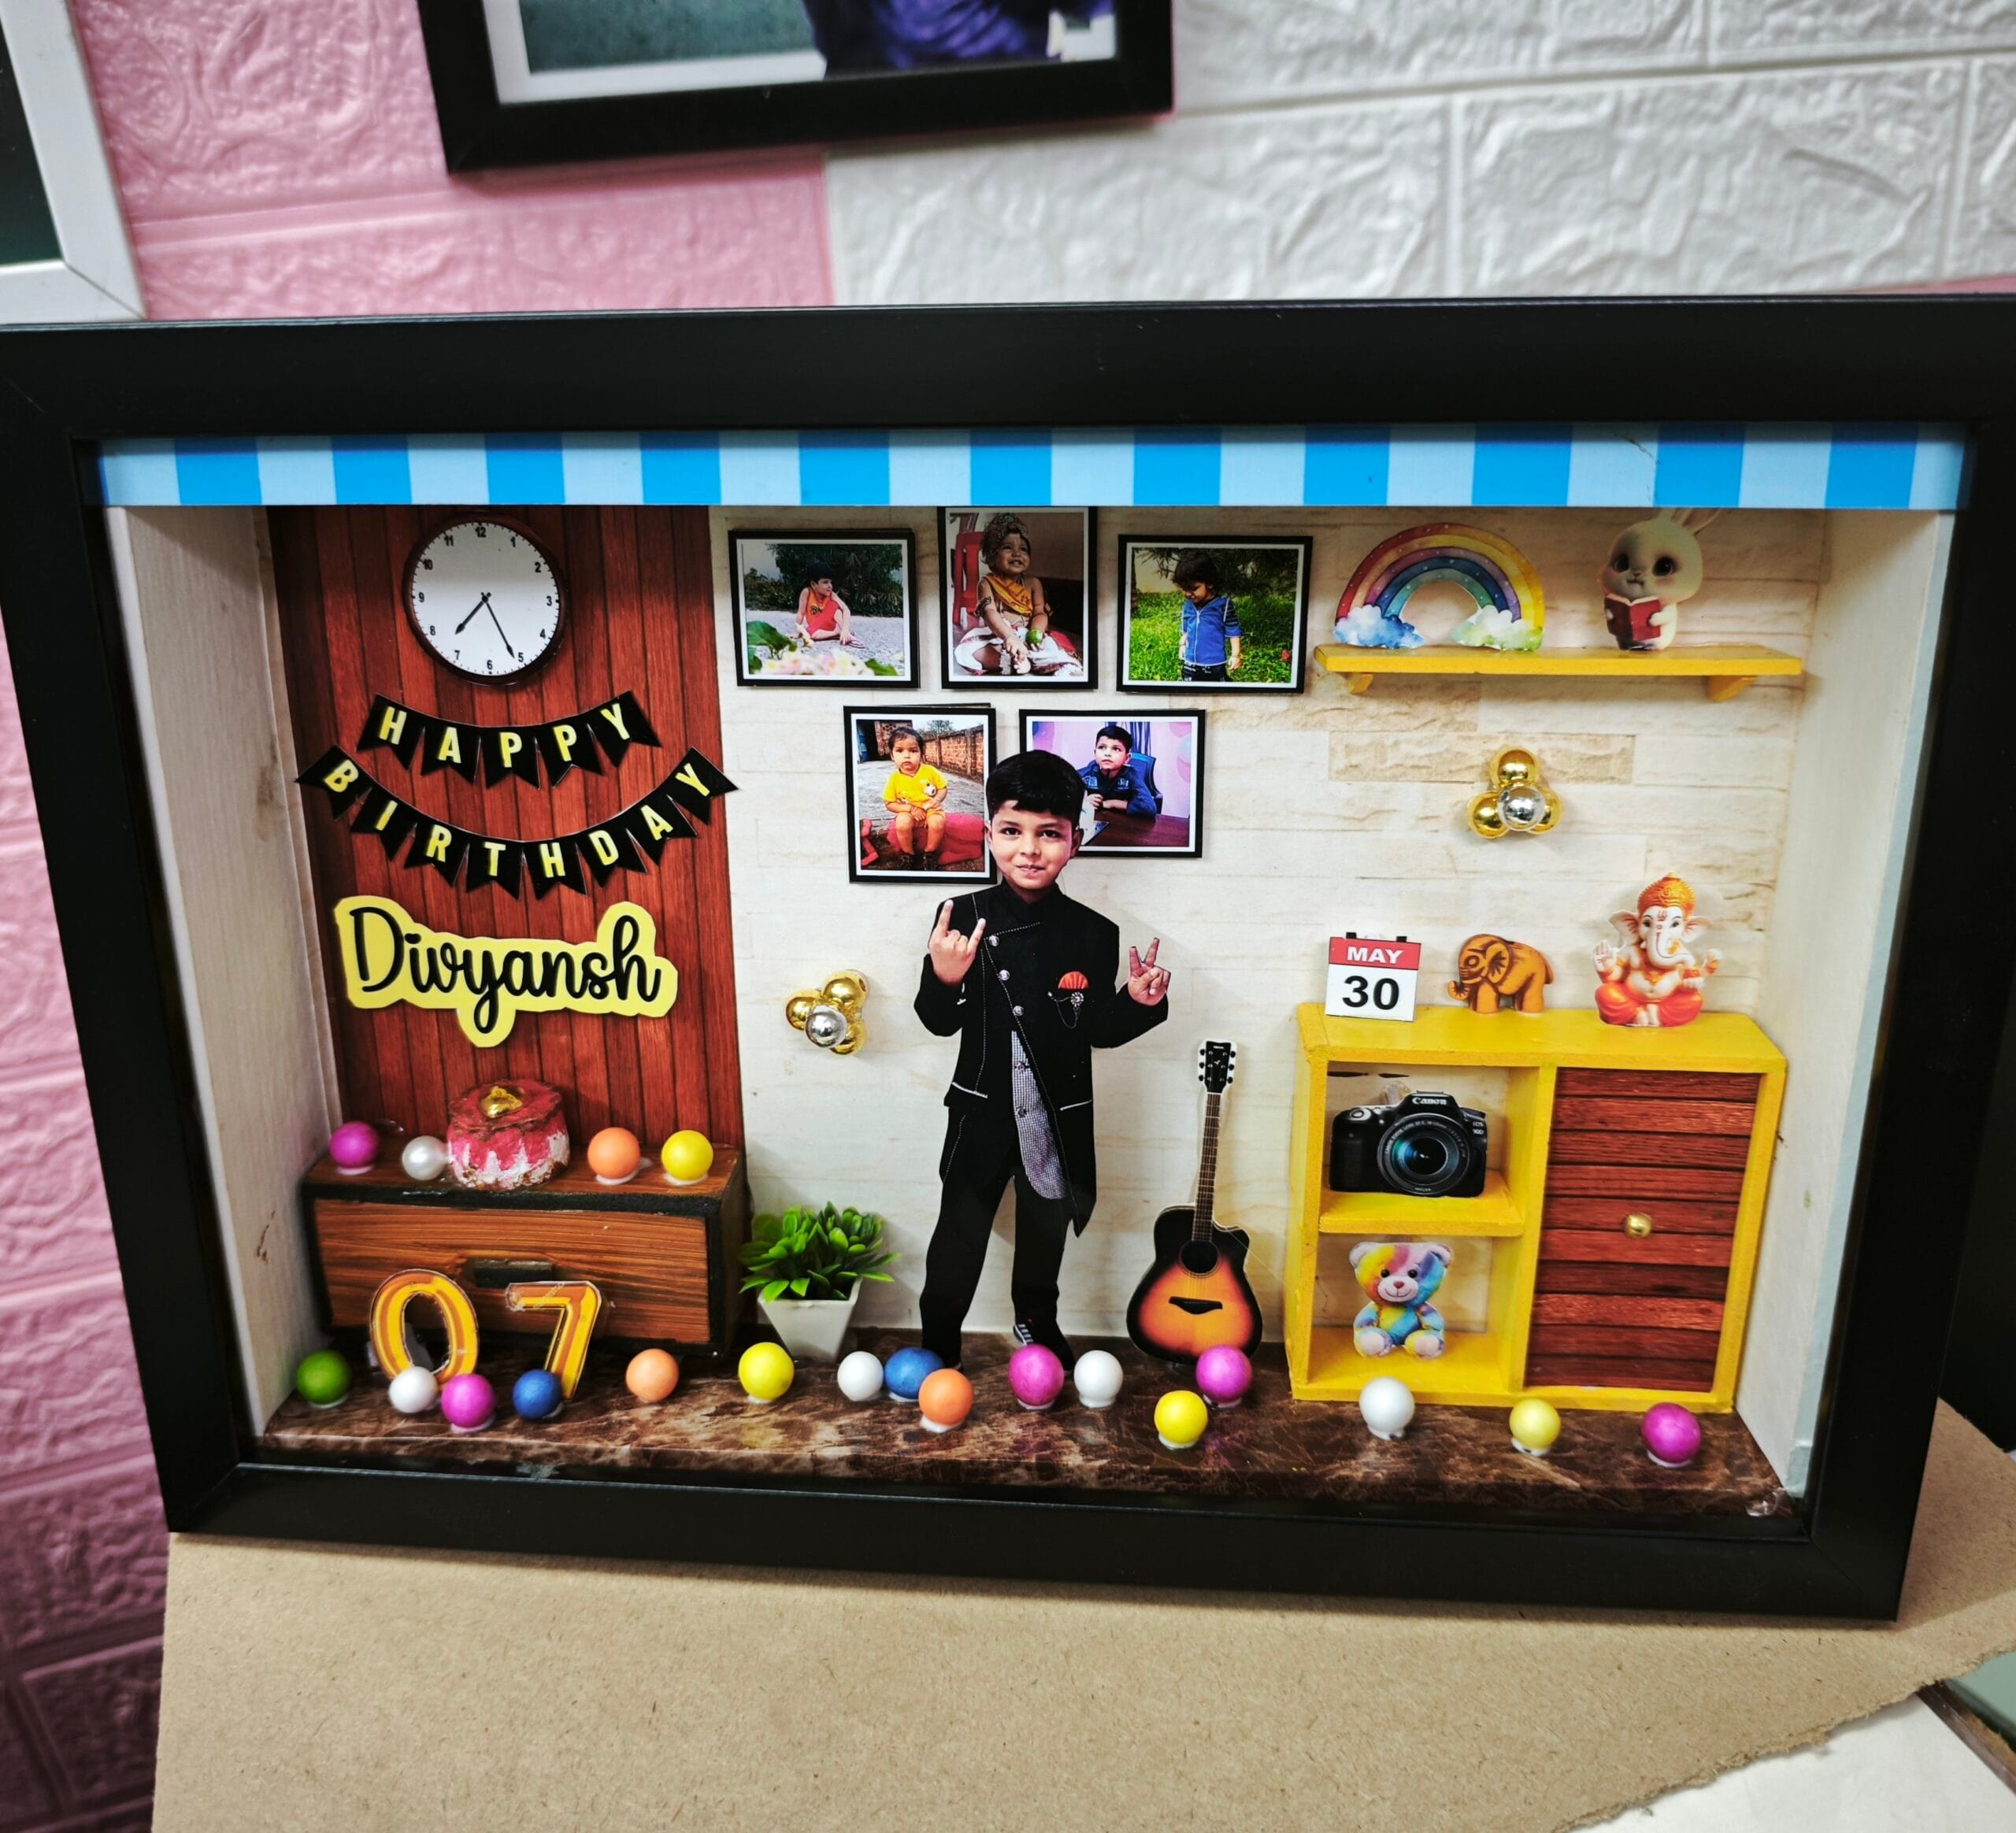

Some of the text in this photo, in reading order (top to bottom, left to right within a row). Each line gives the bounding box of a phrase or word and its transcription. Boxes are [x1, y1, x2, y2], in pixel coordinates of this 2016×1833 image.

[475, 526, 487, 538] 12
[444, 535, 454, 546] 11
[510, 536, 516, 548] 1
[423, 558, 433, 570] 10
[535, 561, 542, 573] 2
[418, 592, 425, 602] 9
[546, 596, 553, 606] 3
[430, 626, 435, 636] 8
[539, 628, 546, 639] 4
[454, 650, 461, 660] 7
[517, 653, 524, 663] 5
[487, 660, 493, 670] 6
[379, 703, 631, 768] HAPPY
[323, 758, 710, 878] BIRTHDAY
[1347, 946, 1403, 965] MAY
[349, 906, 662, 1035] Divyansh
[1342, 975, 1400, 1010] 30
[1412, 1097, 1447, 1105] Canon
[370, 1268, 602, 1400] 07
